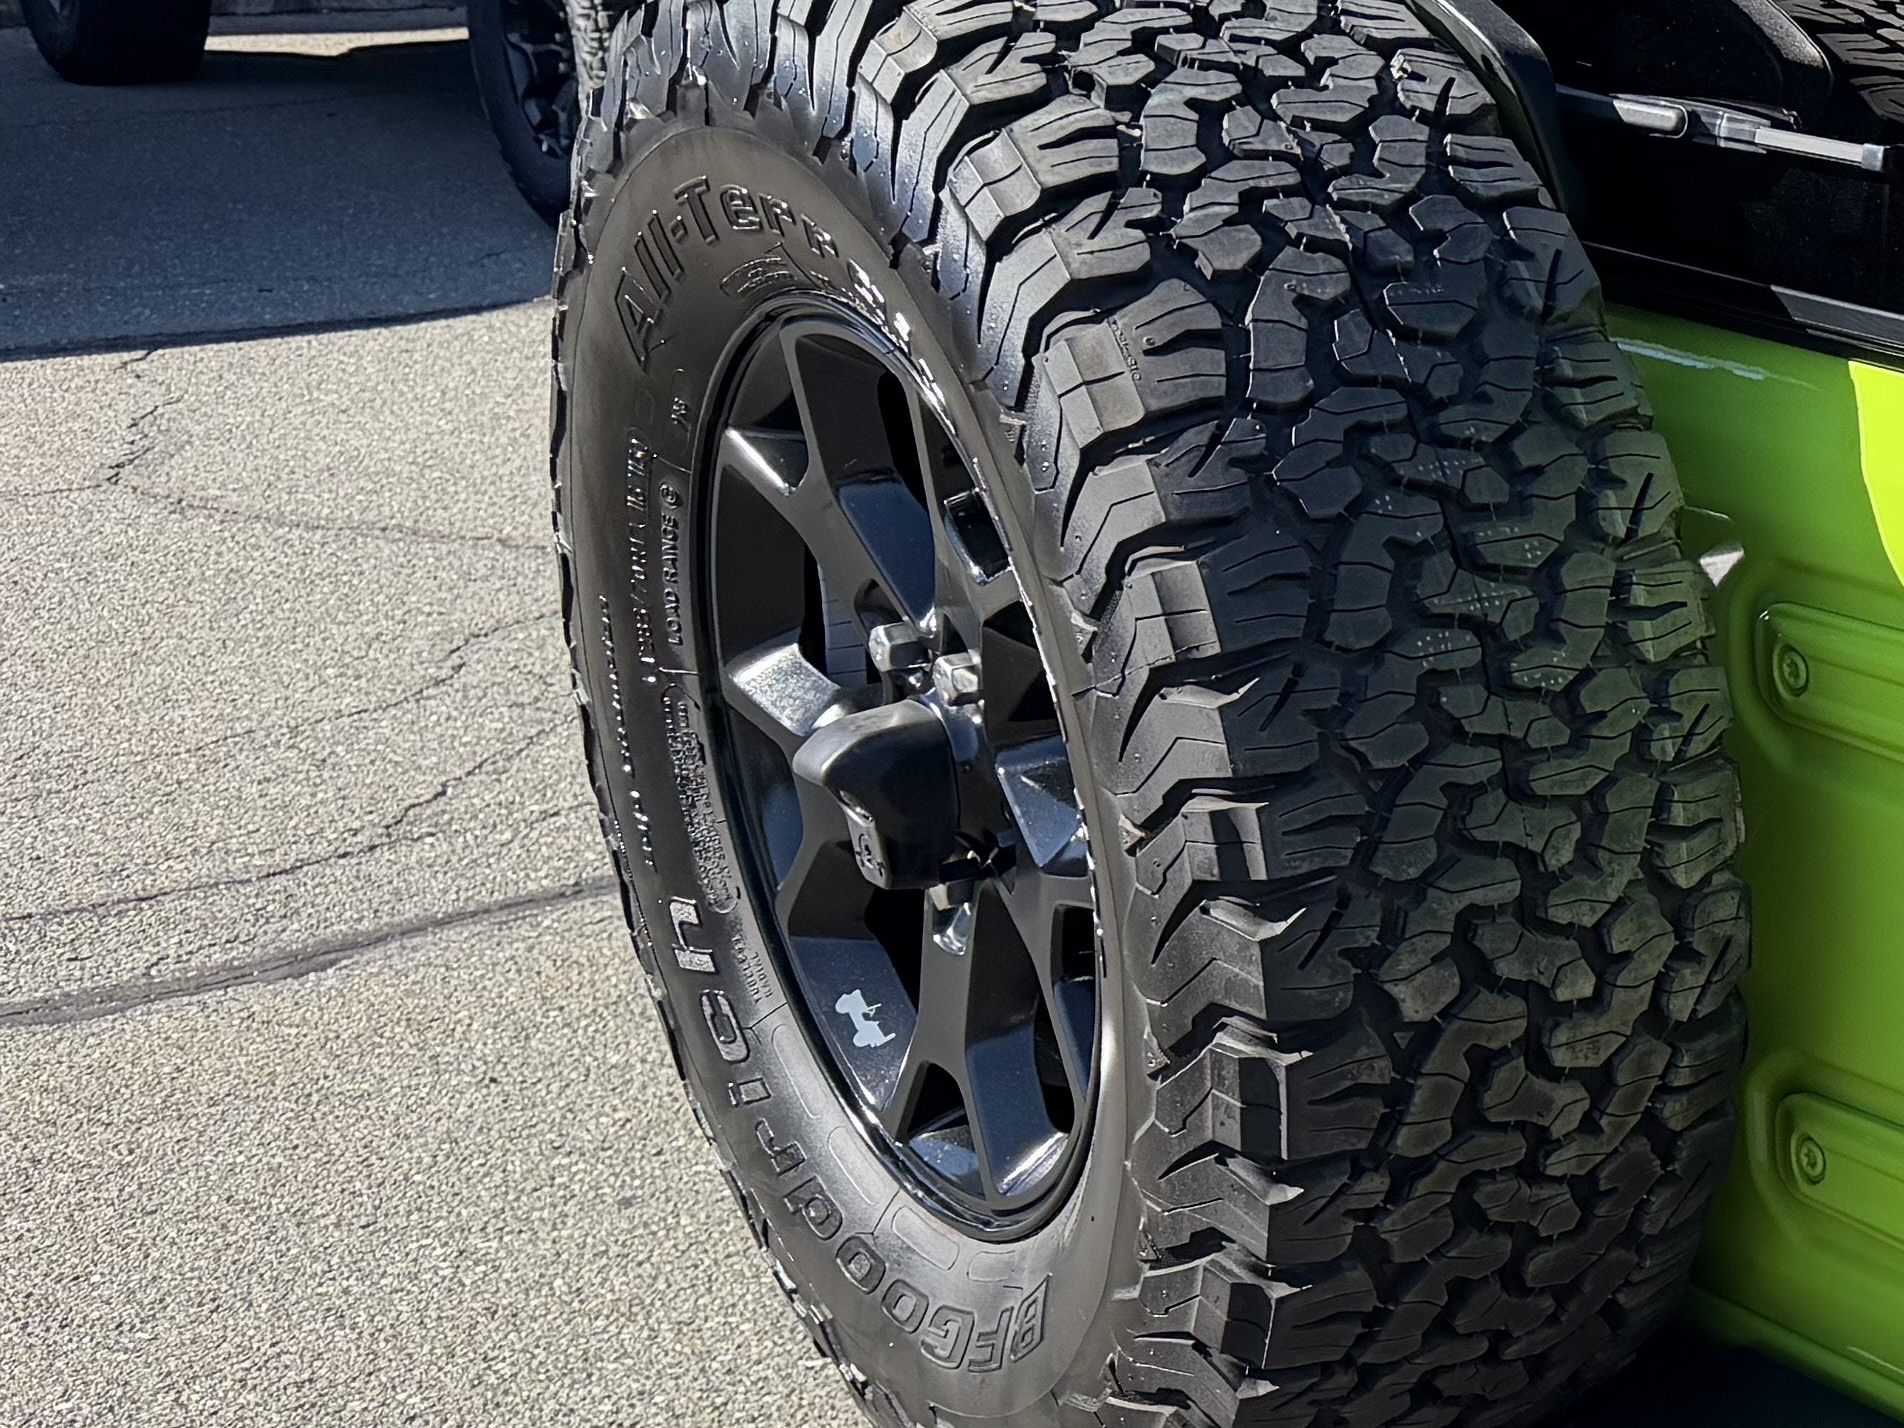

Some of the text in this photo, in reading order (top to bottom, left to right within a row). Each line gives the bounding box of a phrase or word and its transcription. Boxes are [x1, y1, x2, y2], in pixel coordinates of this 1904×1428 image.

[660, 513, 680, 585] RANGE
[664, 587, 684, 647] LOAD
[669, 895, 1053, 1374] BFGoodrich
